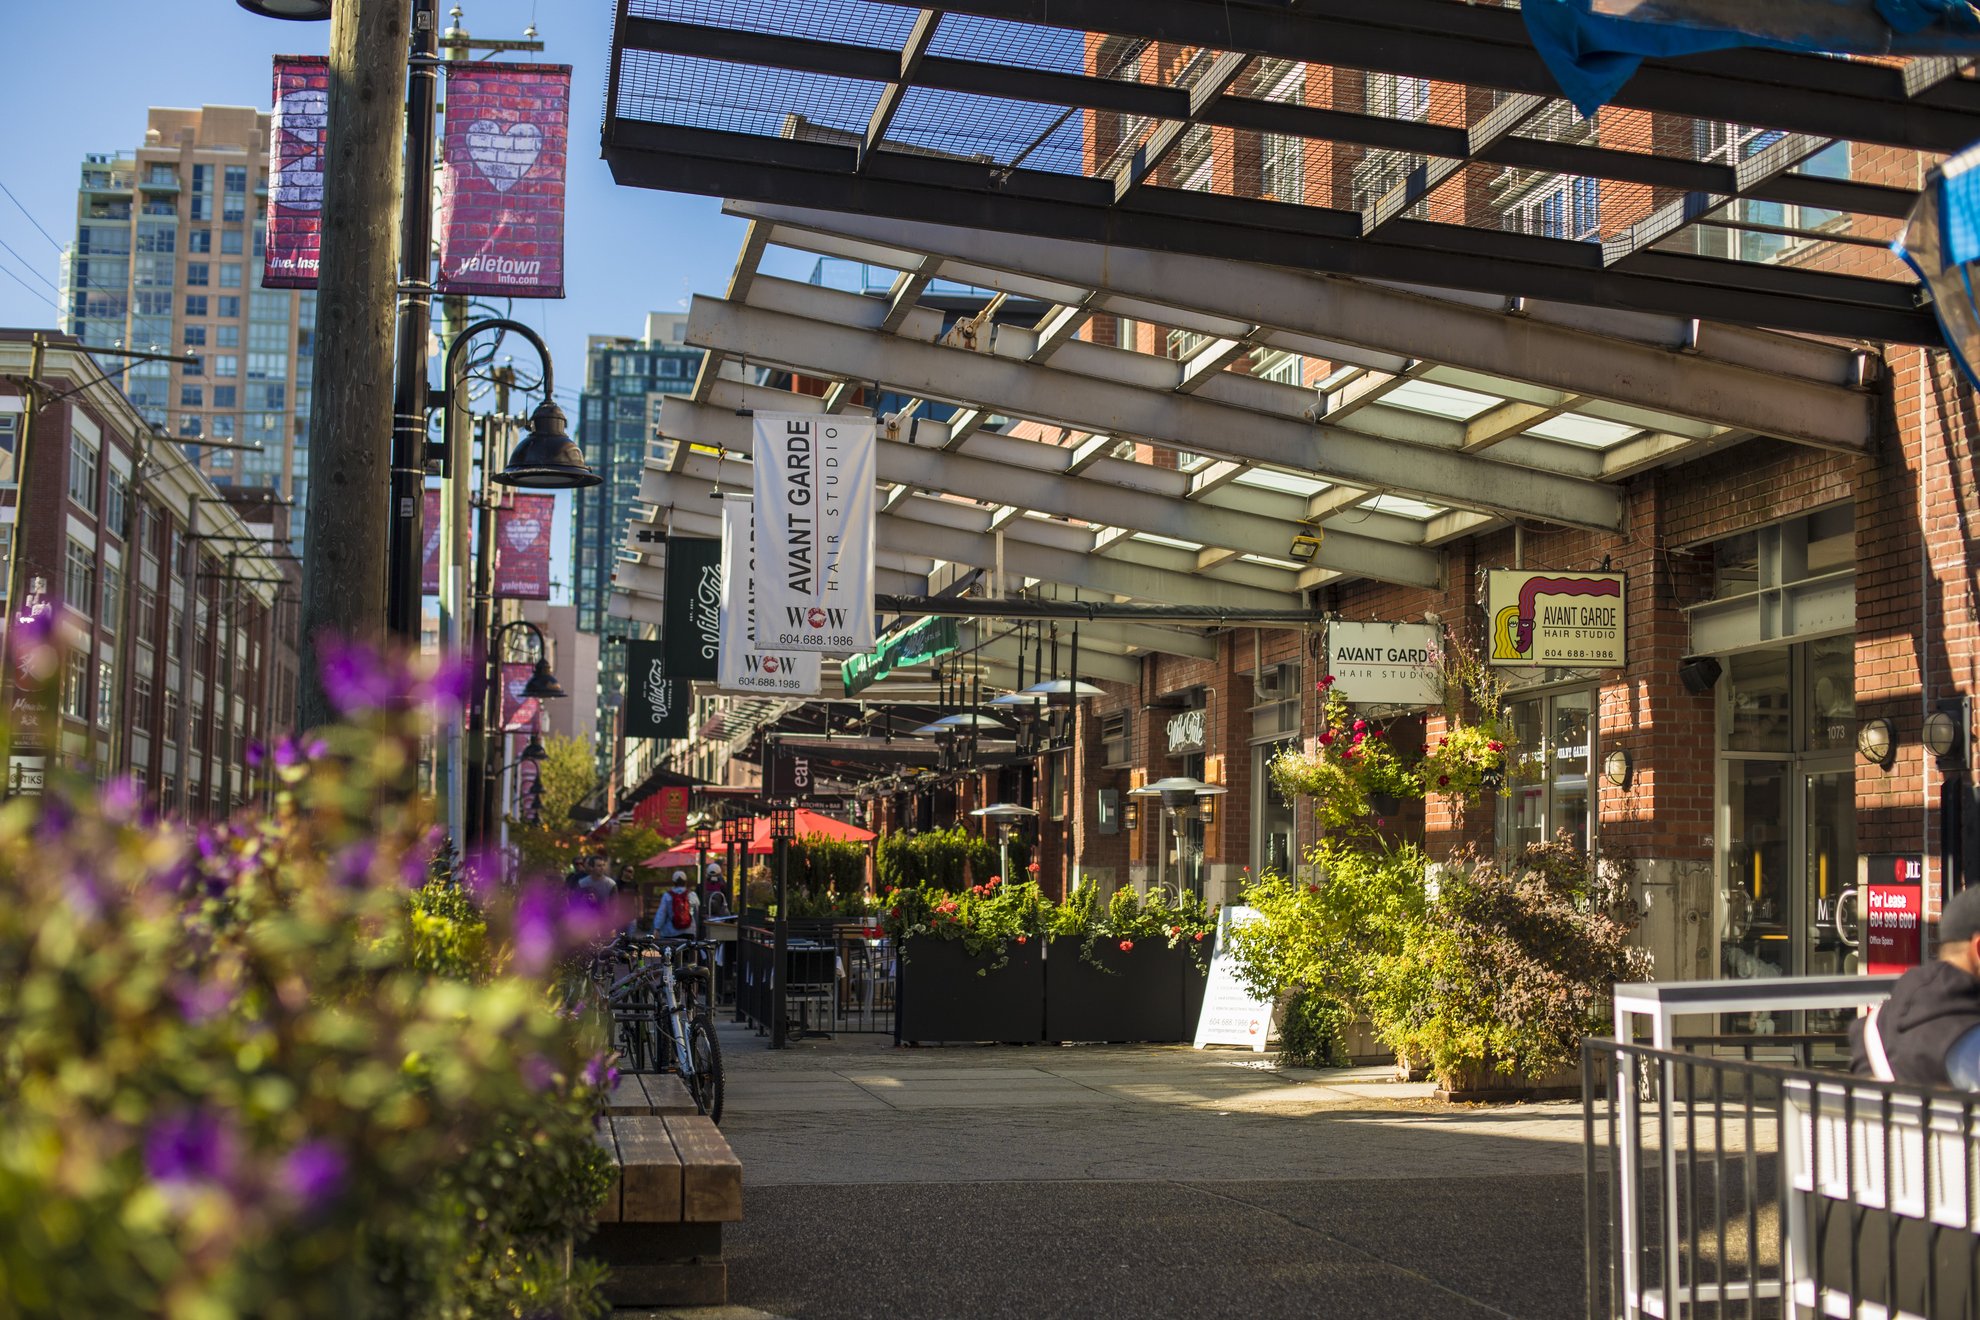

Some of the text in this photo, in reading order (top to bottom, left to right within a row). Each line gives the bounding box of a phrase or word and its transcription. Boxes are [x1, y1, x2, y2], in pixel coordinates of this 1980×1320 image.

[460, 255, 541, 275] yaletown
[498, 274, 538, 285] info.com
[786, 420, 812, 596] AVANT GARDE
[825, 427, 839, 591] HAIR STUDIO
[1543, 605, 1617, 627] AVANT GARDE
[779, 633, 854, 647] 604.688.1986
[1543, 629, 1616, 640] HAIR STUDIO
[1337, 646, 1434, 663] AVANT GARD
[1544, 648, 1614, 659] 604 688-1986
[1338, 669, 1434, 679] HAIR STUDIO
[738, 676, 801, 690] 604.688.1986
[648, 683, 668, 724] Wild
[1827, 724, 1845, 739] 1073
[1869, 890, 1907, 909] For Lease
[1869, 911, 1917, 929] 604 998 6001
[1881, 936, 1894, 946] Space
